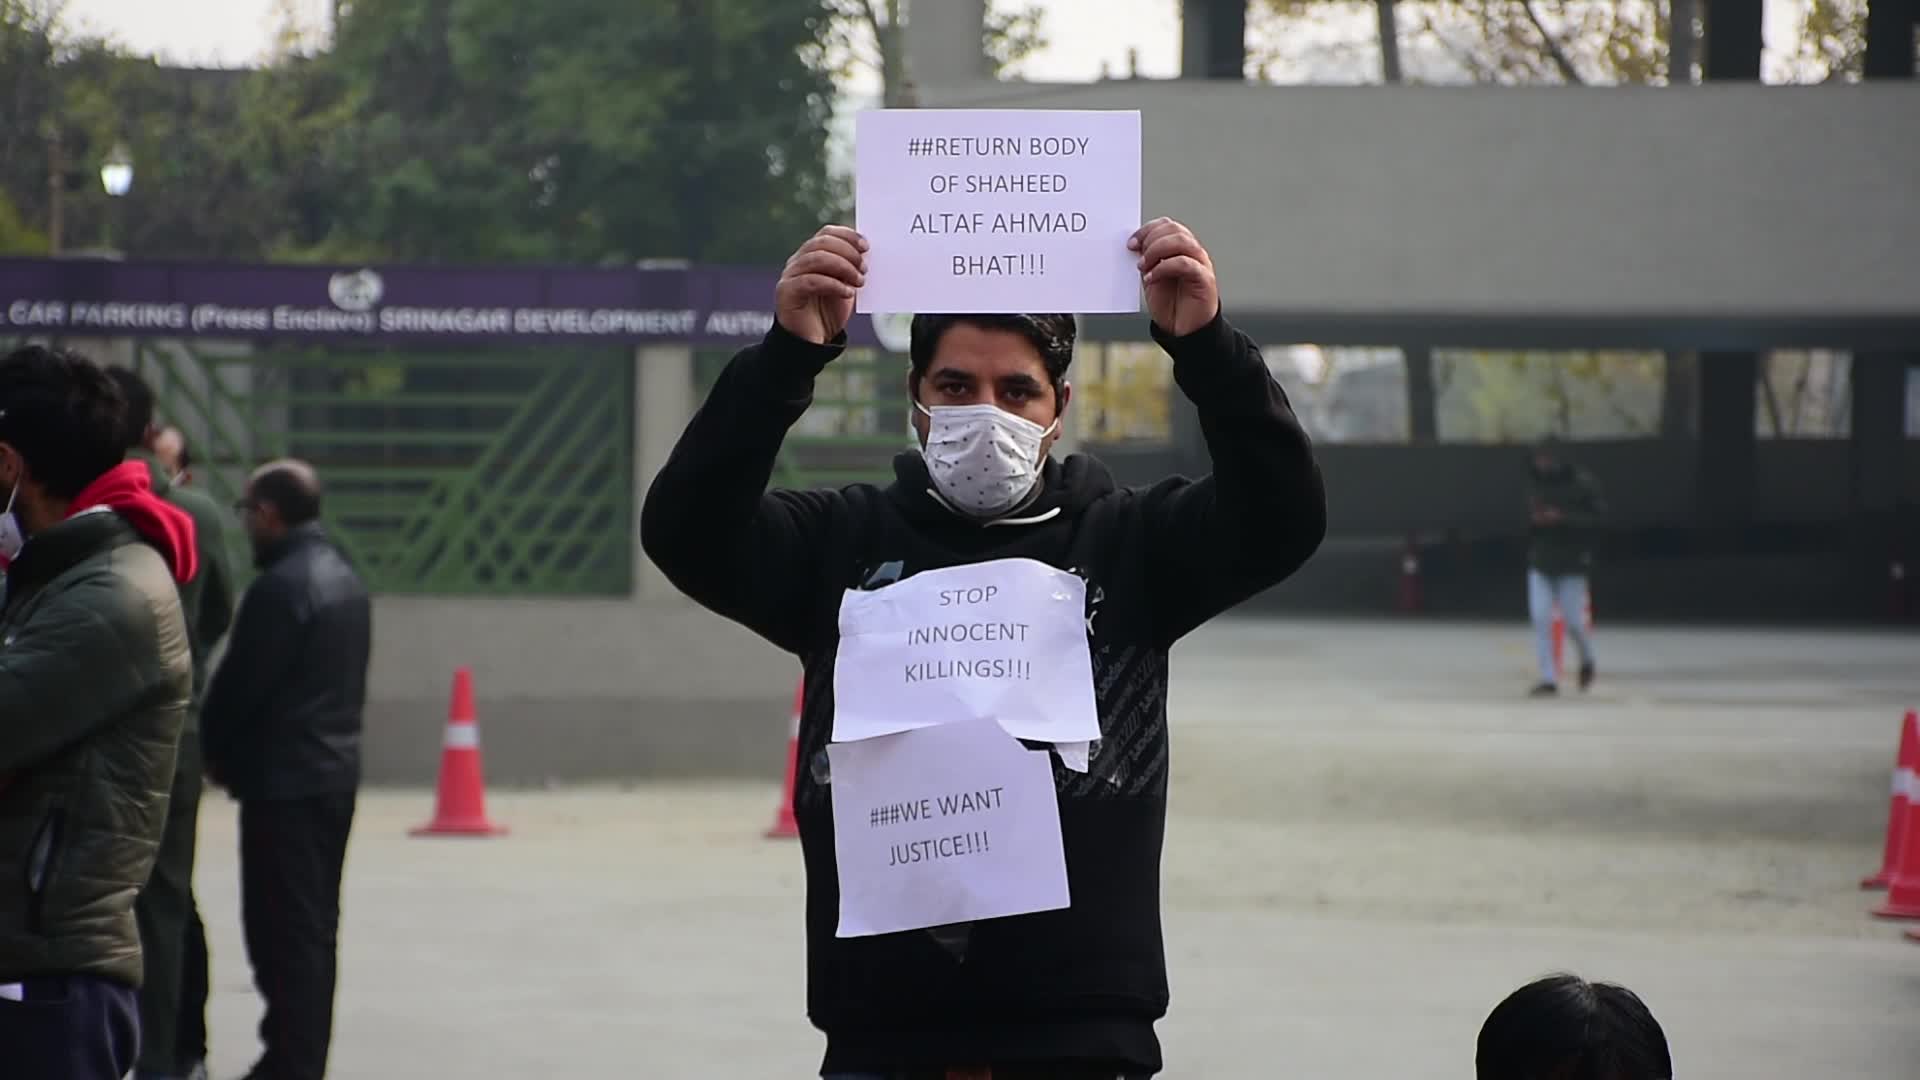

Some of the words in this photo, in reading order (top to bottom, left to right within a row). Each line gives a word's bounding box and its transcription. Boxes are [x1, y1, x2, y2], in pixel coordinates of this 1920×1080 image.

[908, 137, 1022, 156] ##RETURN
[1030, 137, 1090, 156] BODY
[930, 175, 959, 193] OF
[966, 174, 1068, 193] SHAHEED
[910, 213, 985, 234] ALTAF
[992, 212, 1088, 234] AHMAD
[952, 254, 1046, 276] BHAT!!!
[8, 300, 65, 326] CAR
[70, 302, 188, 328] PARKING
[191, 304, 269, 333] (Press
[272, 305, 374, 333] Enclave)
[379, 307, 506, 334] SRINAGAR
[514, 309, 697, 335] DEVELOPMENT
[939, 585, 998, 606] STOP
[908, 623, 1030, 646] INNOCENT
[905, 659, 1031, 683] KILLINGS!!!
[870, 799, 932, 828] ###WE
[937, 787, 1003, 816] WANT
[889, 830, 989, 866] JUSTICE!!!
